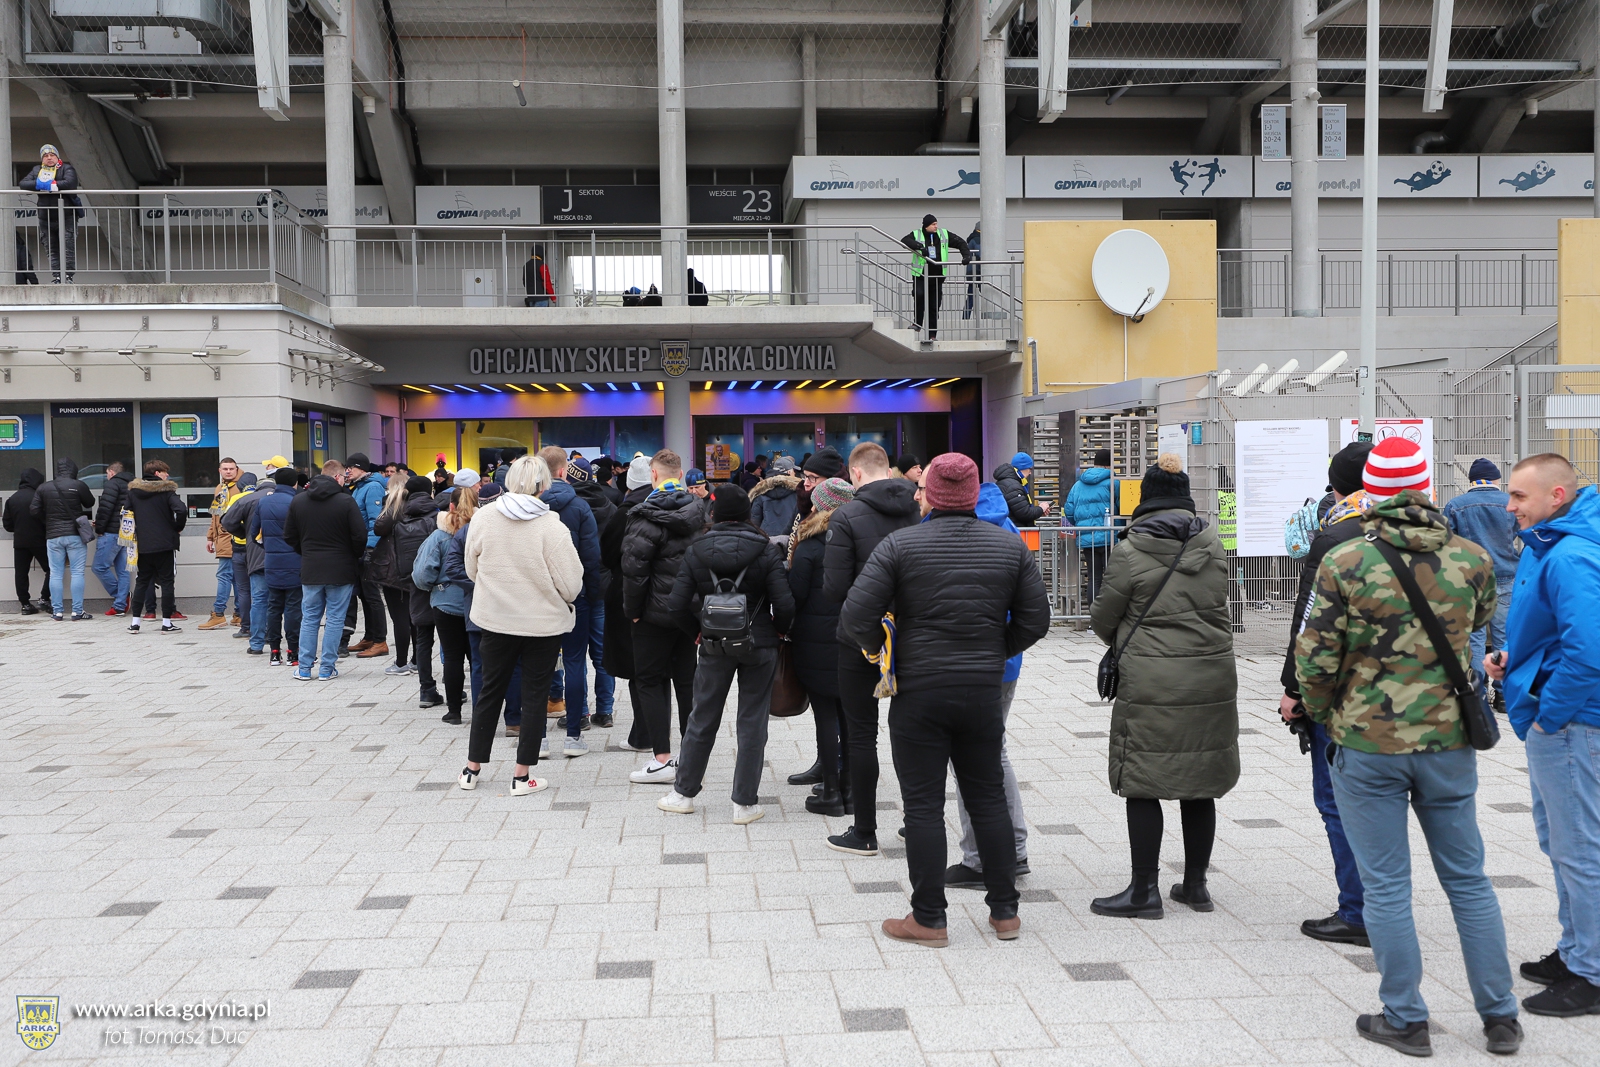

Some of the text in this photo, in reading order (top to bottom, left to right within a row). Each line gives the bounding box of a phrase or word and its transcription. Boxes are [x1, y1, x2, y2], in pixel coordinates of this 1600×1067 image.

[561, 189, 573, 213] J
[708, 189, 737, 197] WEJŚCIE
[742, 189, 772, 213] 23
[470, 346, 651, 374] OFICJALNY SKLEP
[700, 345, 837, 372] ARKA GDYNIA
